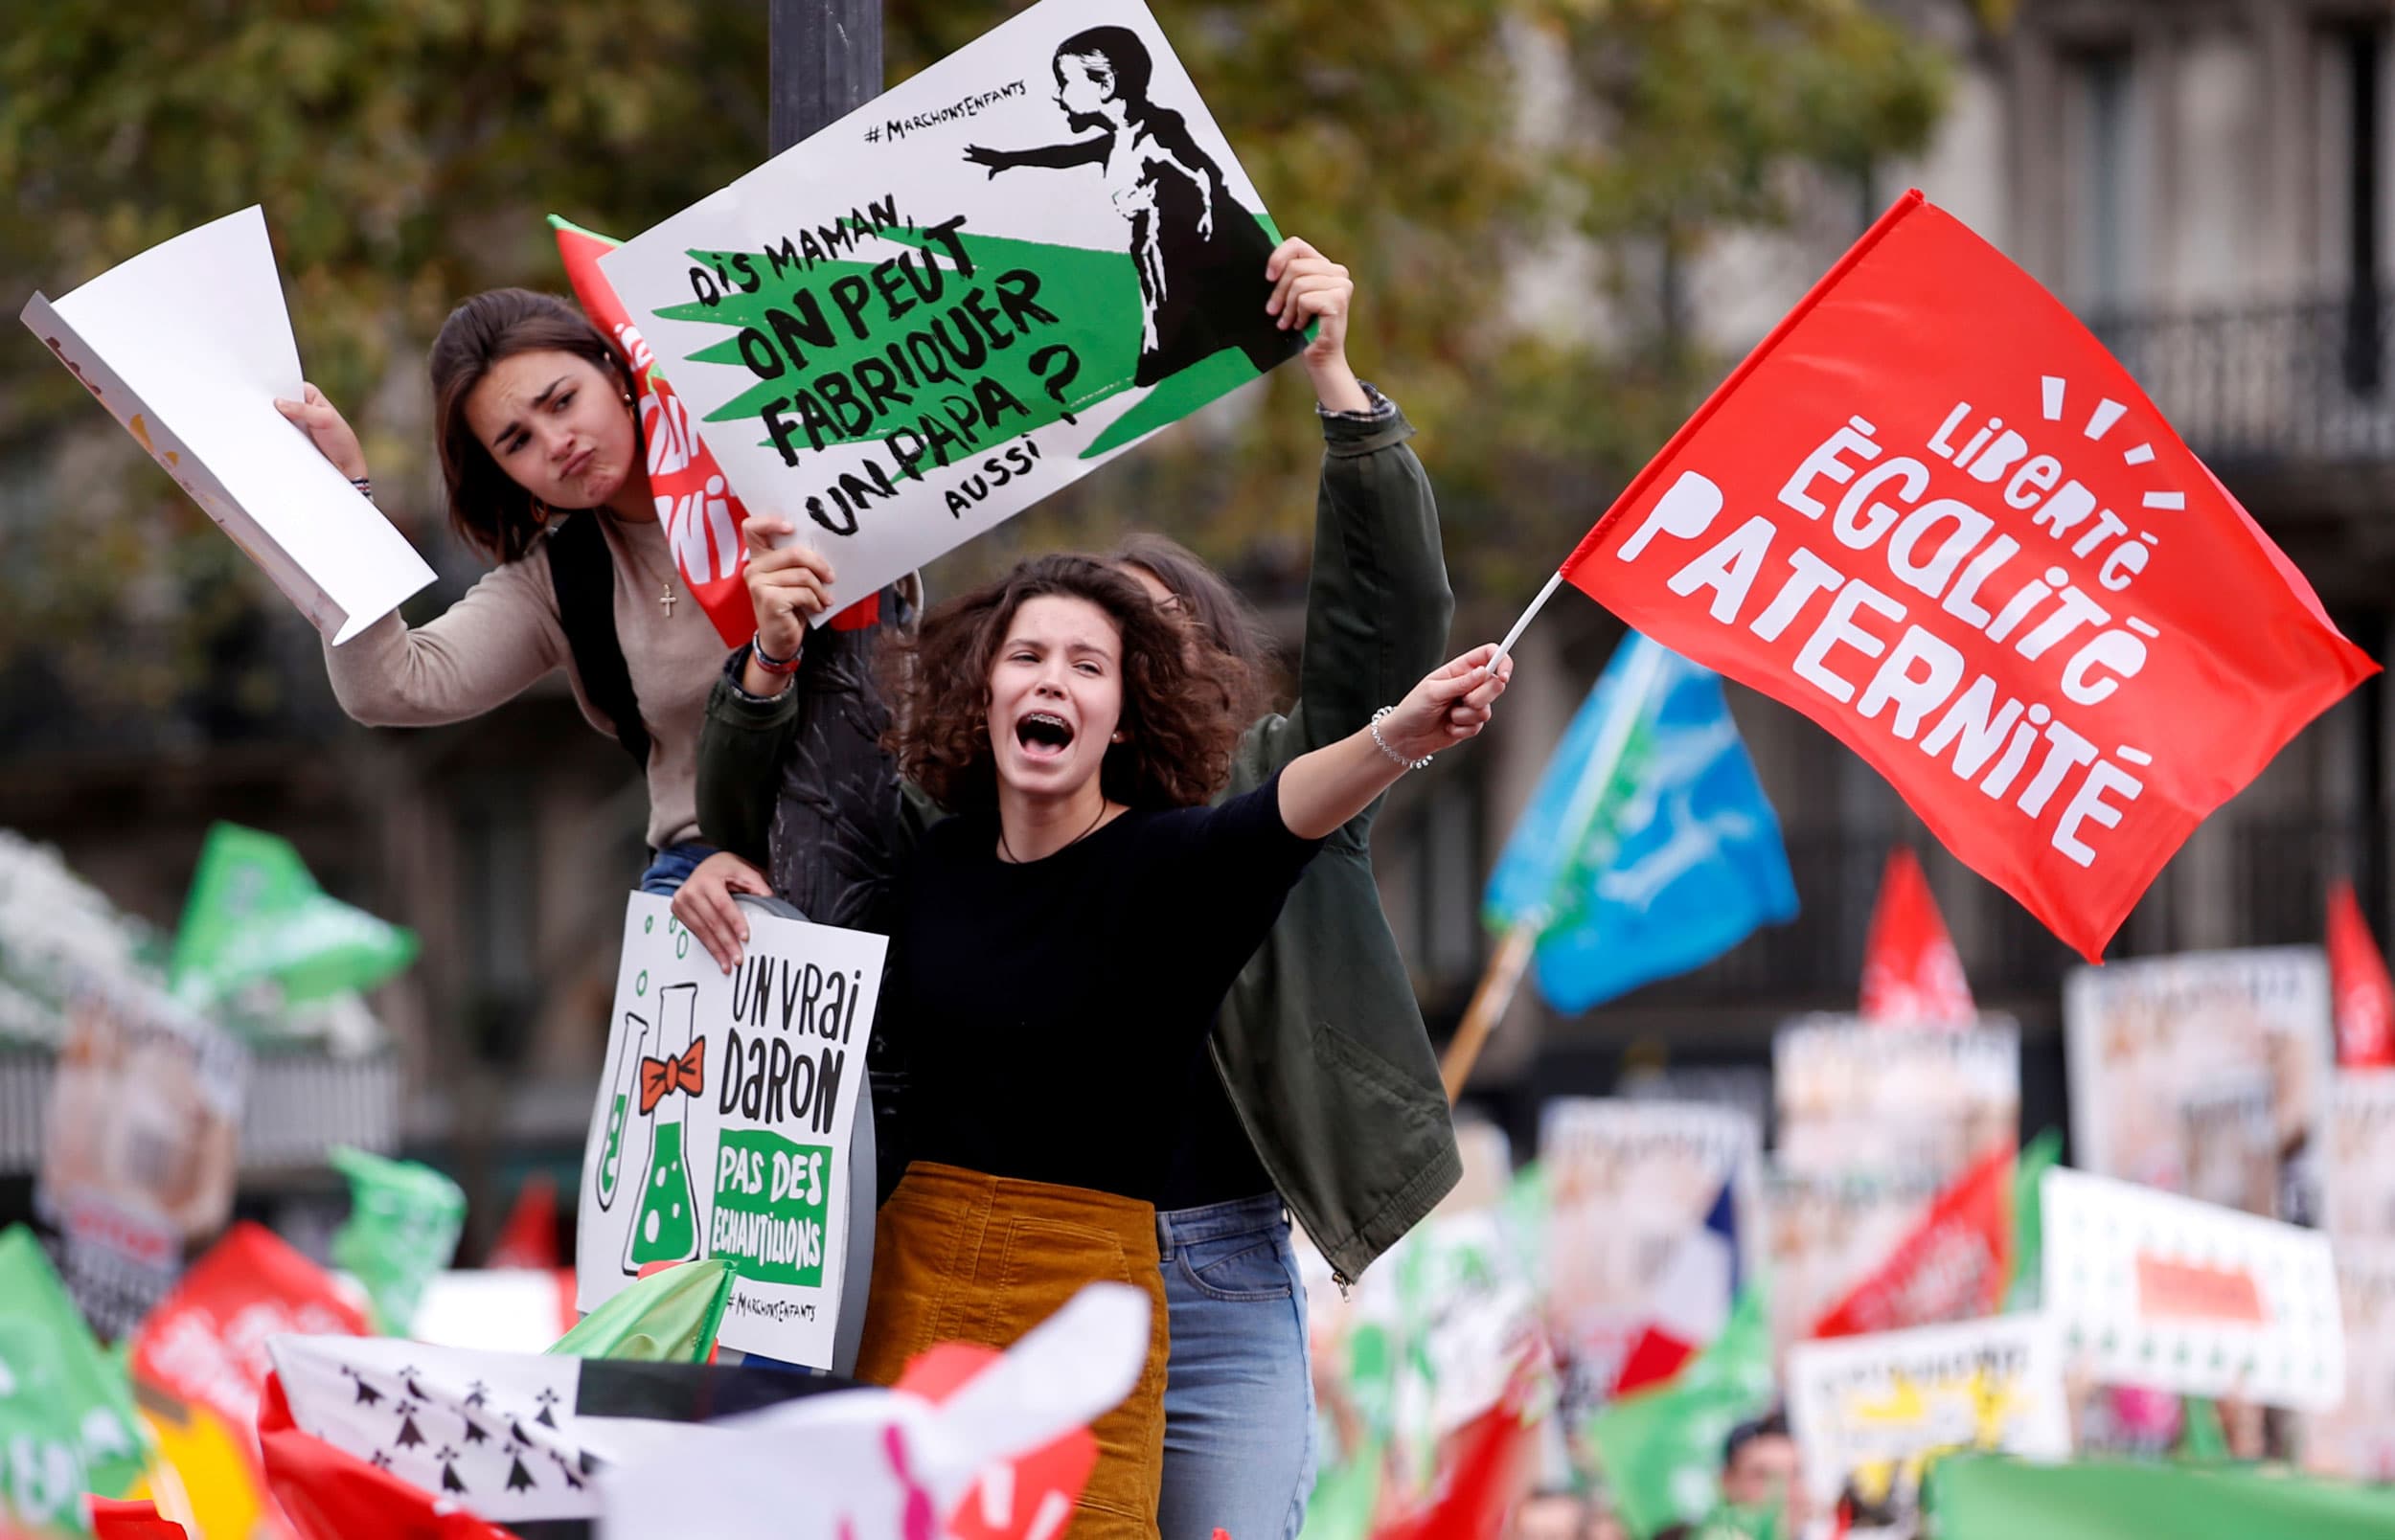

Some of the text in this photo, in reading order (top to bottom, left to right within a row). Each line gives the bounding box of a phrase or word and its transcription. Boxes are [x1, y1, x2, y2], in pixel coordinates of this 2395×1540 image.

[738, 287, 837, 380] ON
[829, 215, 975, 340] PEUT
[764, 192, 913, 281] MAMAN,
[761, 268, 1060, 467] FABRIQUER
[806, 459, 900, 536] UN
[884, 376, 1032, 482] PAPA
[1028, 344, 1081, 426] ?
[733, 954, 775, 1028] UN
[718, 1145, 823, 1206] PAS DES
